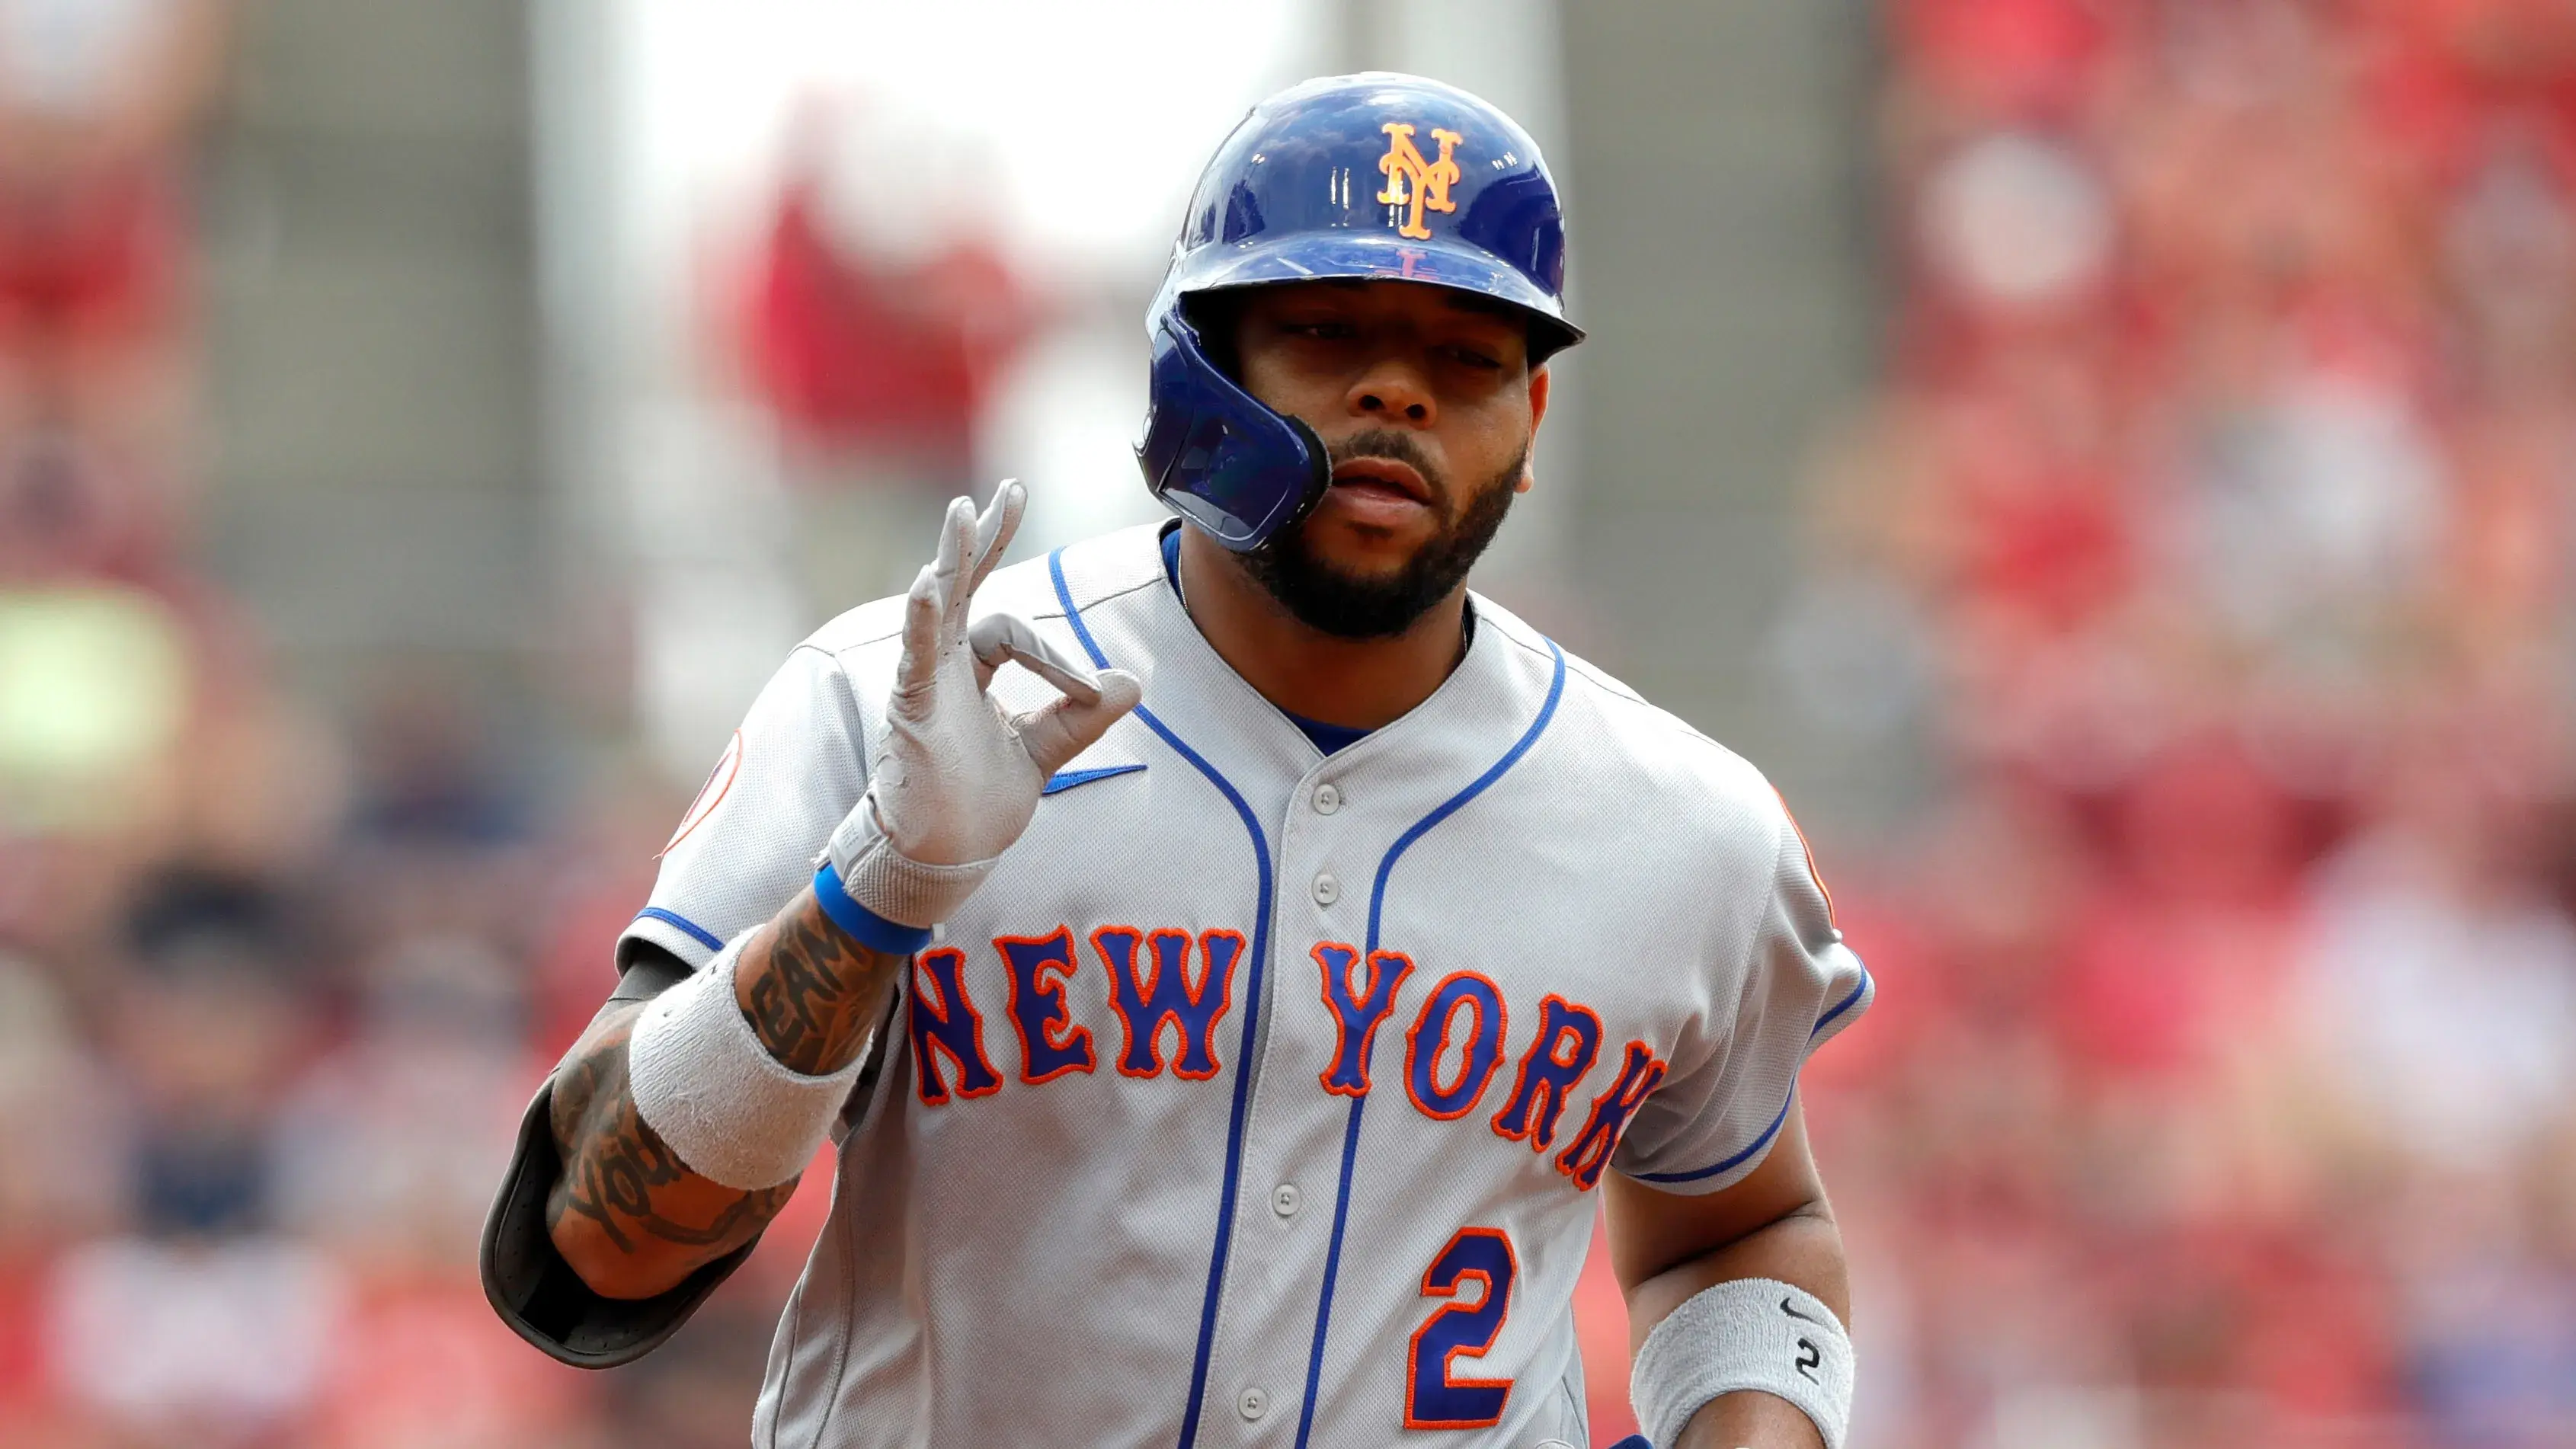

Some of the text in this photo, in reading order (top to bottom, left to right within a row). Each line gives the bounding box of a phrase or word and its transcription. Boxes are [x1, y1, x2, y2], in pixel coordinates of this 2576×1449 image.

[742, 907, 873, 1059] EAM
[907, 923, 1668, 1191] NEW YORK
[1403, 1226, 1518, 1429] 2
[1795, 1337, 1821, 1385] 2
